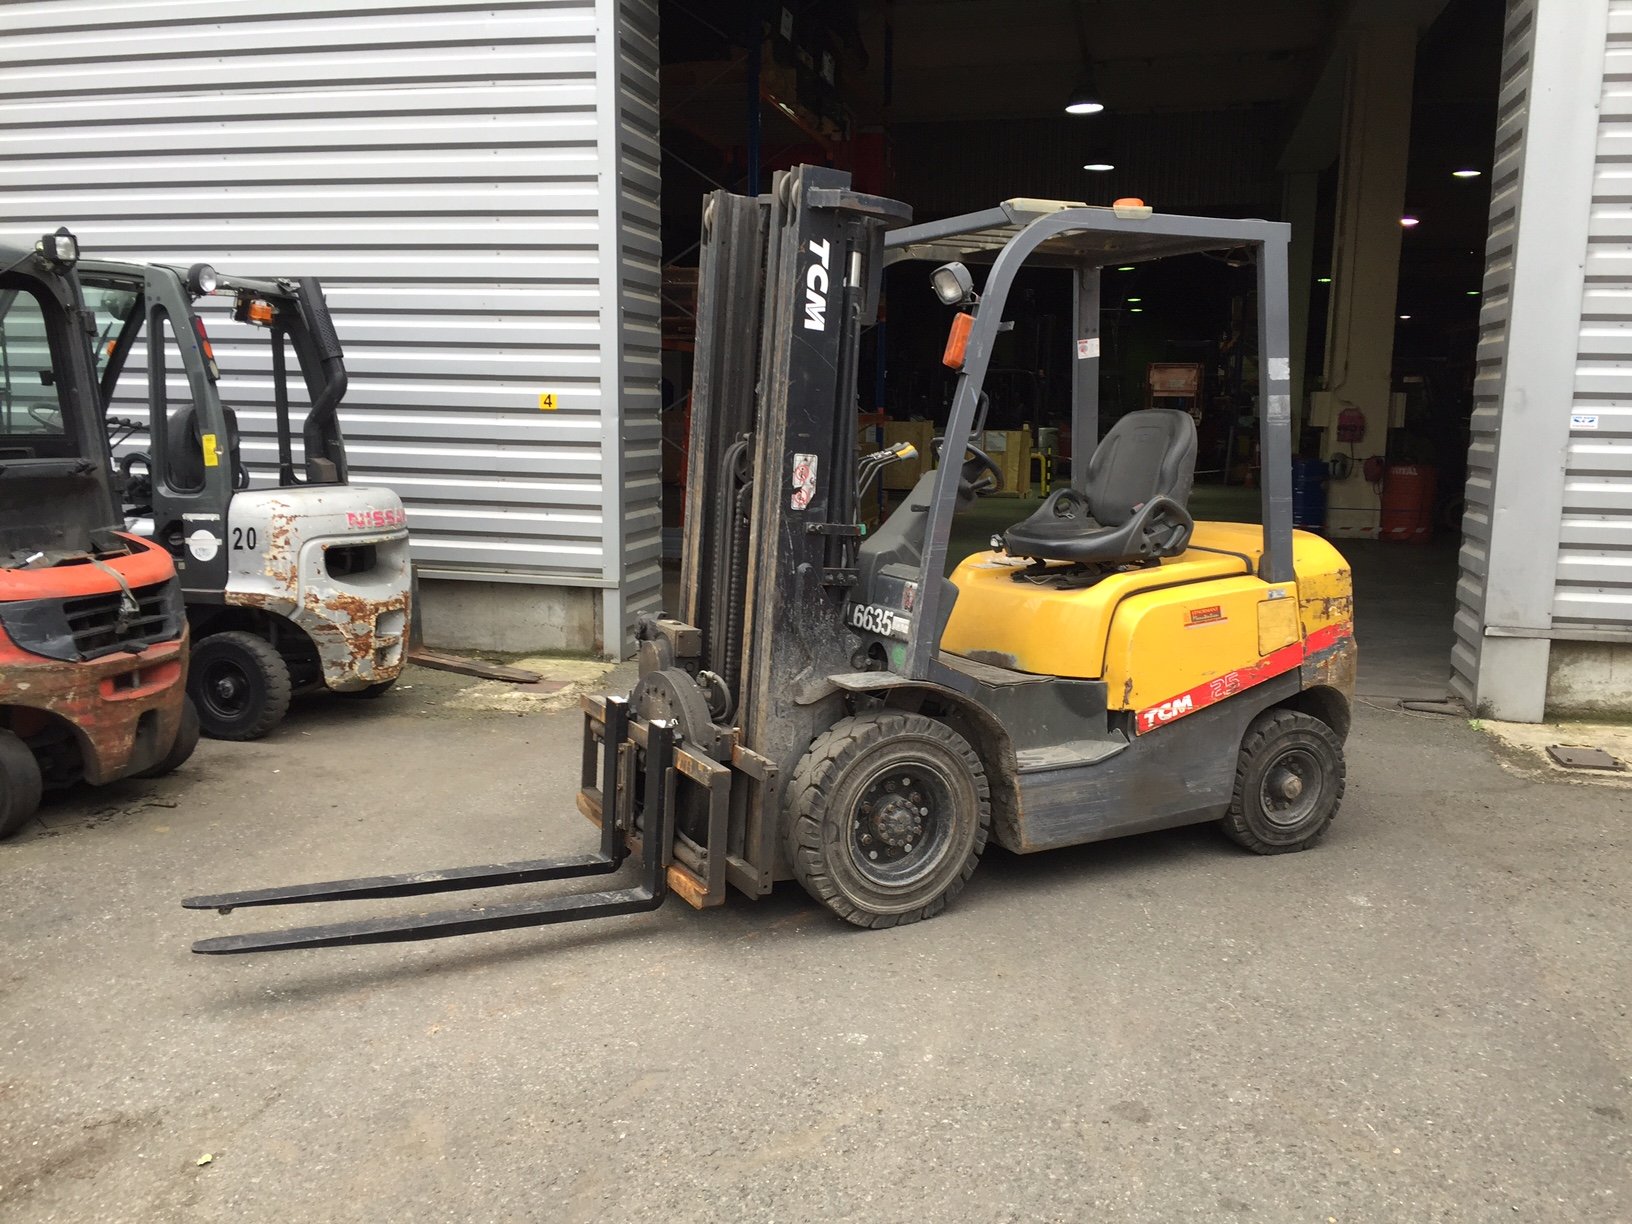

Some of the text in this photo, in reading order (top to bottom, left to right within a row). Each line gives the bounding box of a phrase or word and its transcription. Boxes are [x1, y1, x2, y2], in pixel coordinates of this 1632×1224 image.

[804, 238, 830, 331] TCM
[544, 394, 552, 407] 4
[346, 508, 407, 529] NISSA
[232, 527, 257, 550] 20
[853, 604, 894, 636] 6635
[1144, 672, 1240, 727] TCM 25
